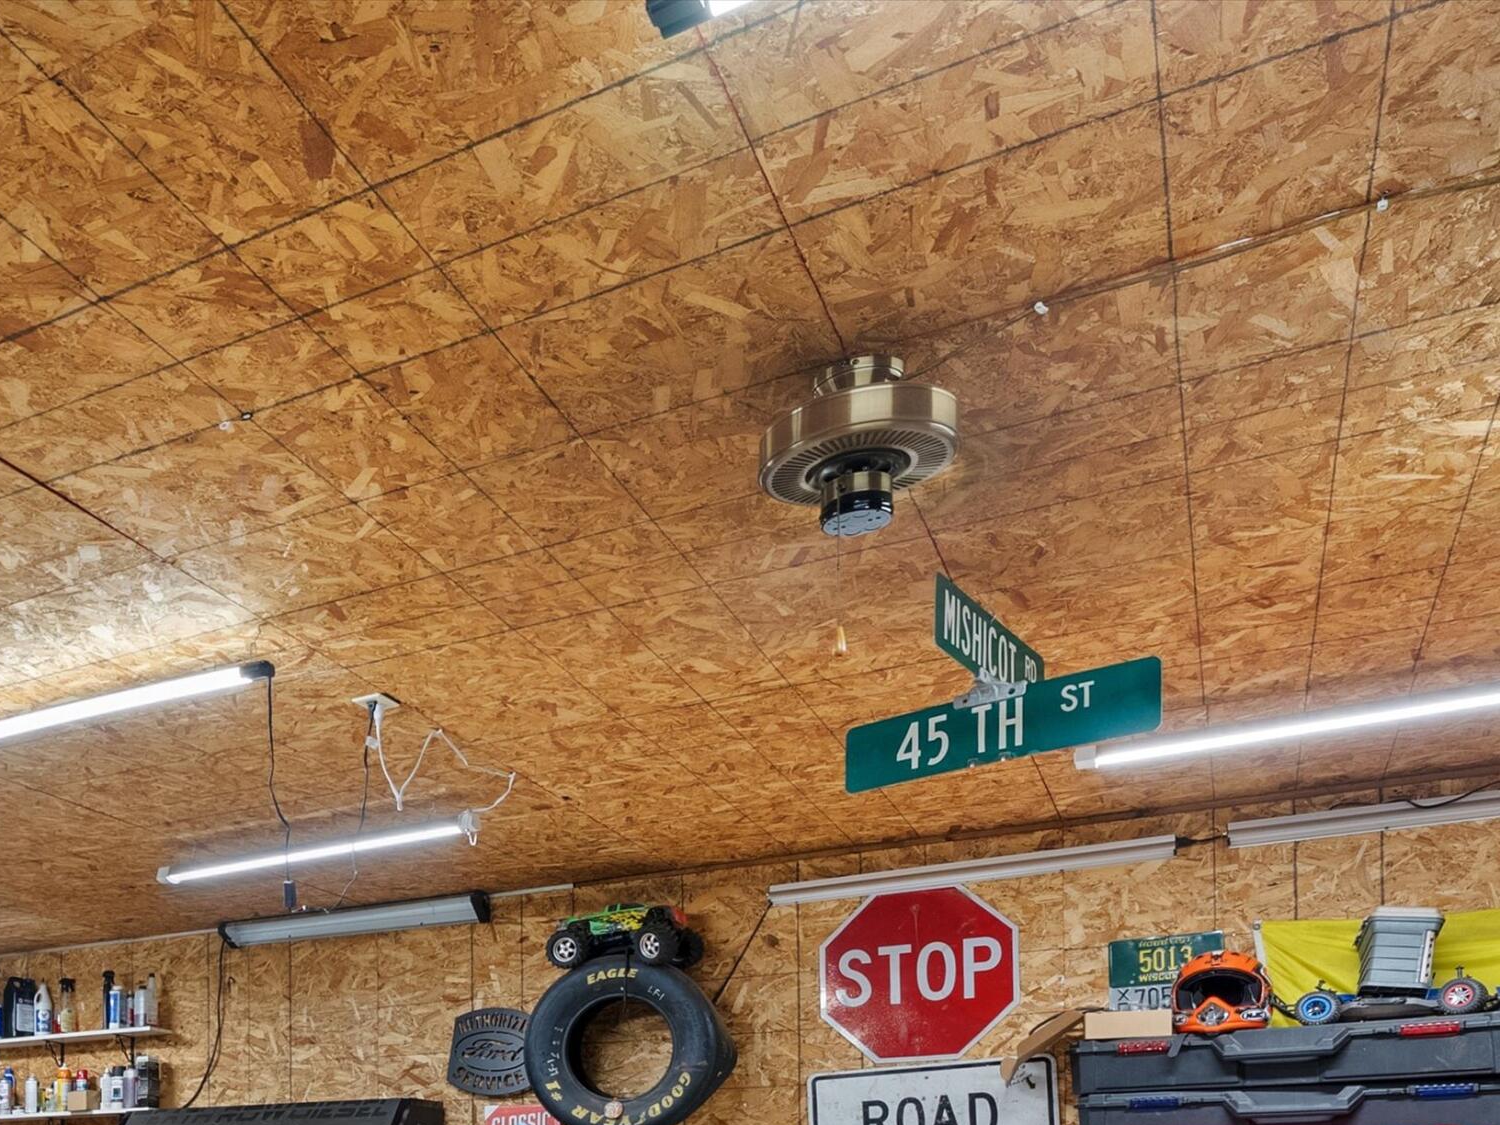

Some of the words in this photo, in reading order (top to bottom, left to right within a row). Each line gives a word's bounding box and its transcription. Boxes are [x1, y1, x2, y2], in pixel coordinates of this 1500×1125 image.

[944, 589, 1017, 685] MISHICOT
[1024, 655, 1037, 683] RD
[896, 714, 950, 769] 45
[971, 696, 1023, 753] TH
[1060, 680, 1095, 712] ST
[586, 967, 639, 985] EAGLE
[836, 937, 1002, 1007] STOP
[462, 1039, 525, 1062] Ford
[453, 1067, 526, 1090] SERVICE
